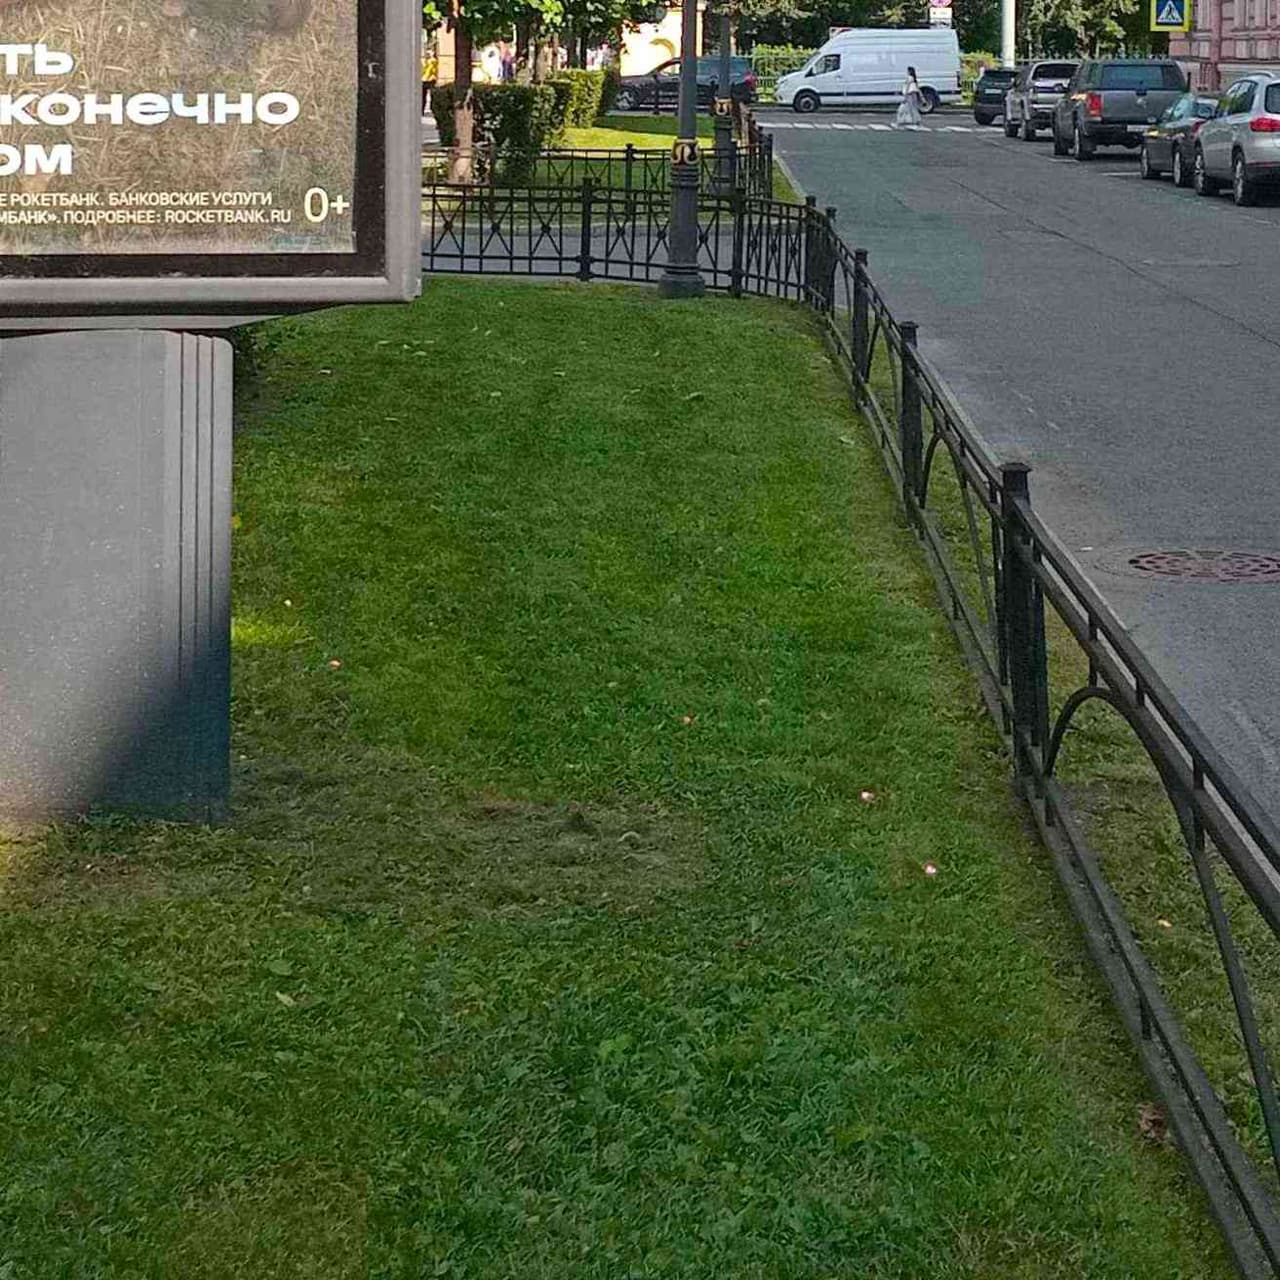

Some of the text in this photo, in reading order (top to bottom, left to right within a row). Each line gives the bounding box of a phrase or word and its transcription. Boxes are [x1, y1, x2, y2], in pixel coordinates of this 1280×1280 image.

[10, 192, 104, 207] РОКЕТБАНК.
[108, 192, 209, 206] БАНКОВСКИЕ
[211, 191, 273, 206] УСЛУГИ
[303, 186, 351, 223] 0+
[63, 210, 162, 225] ПОДРОБНЕЕ:
[164, 209, 292, 224] ROCKETBANK.RU
